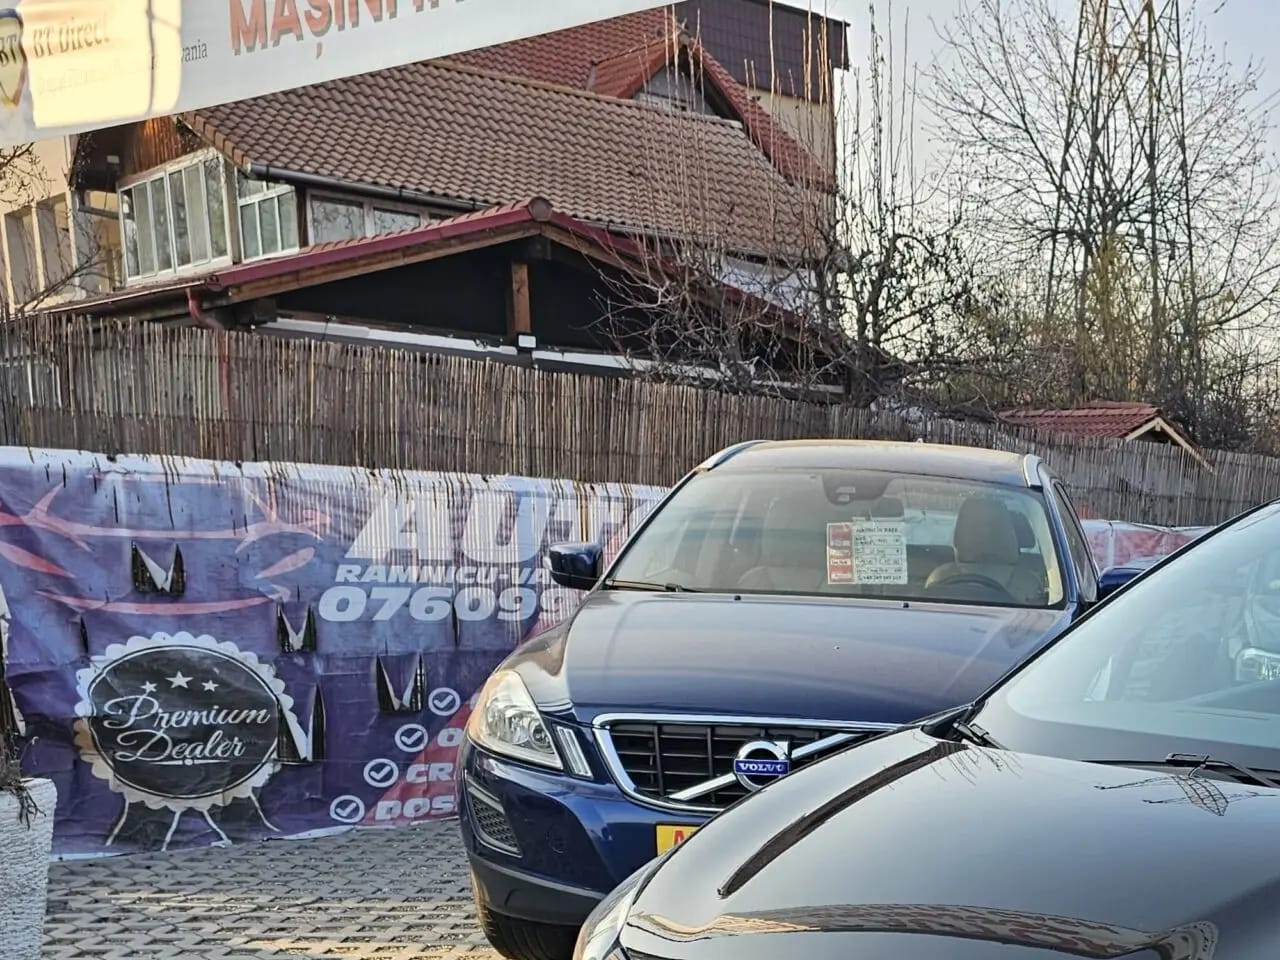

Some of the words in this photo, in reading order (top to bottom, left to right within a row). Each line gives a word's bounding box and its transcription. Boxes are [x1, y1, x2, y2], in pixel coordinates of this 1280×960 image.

[345, 496, 655, 563] AUT
[103, 694, 270, 729] Premium
[114, 728, 246, 761] Dealer
[738, 762, 785, 772] VOLVO
